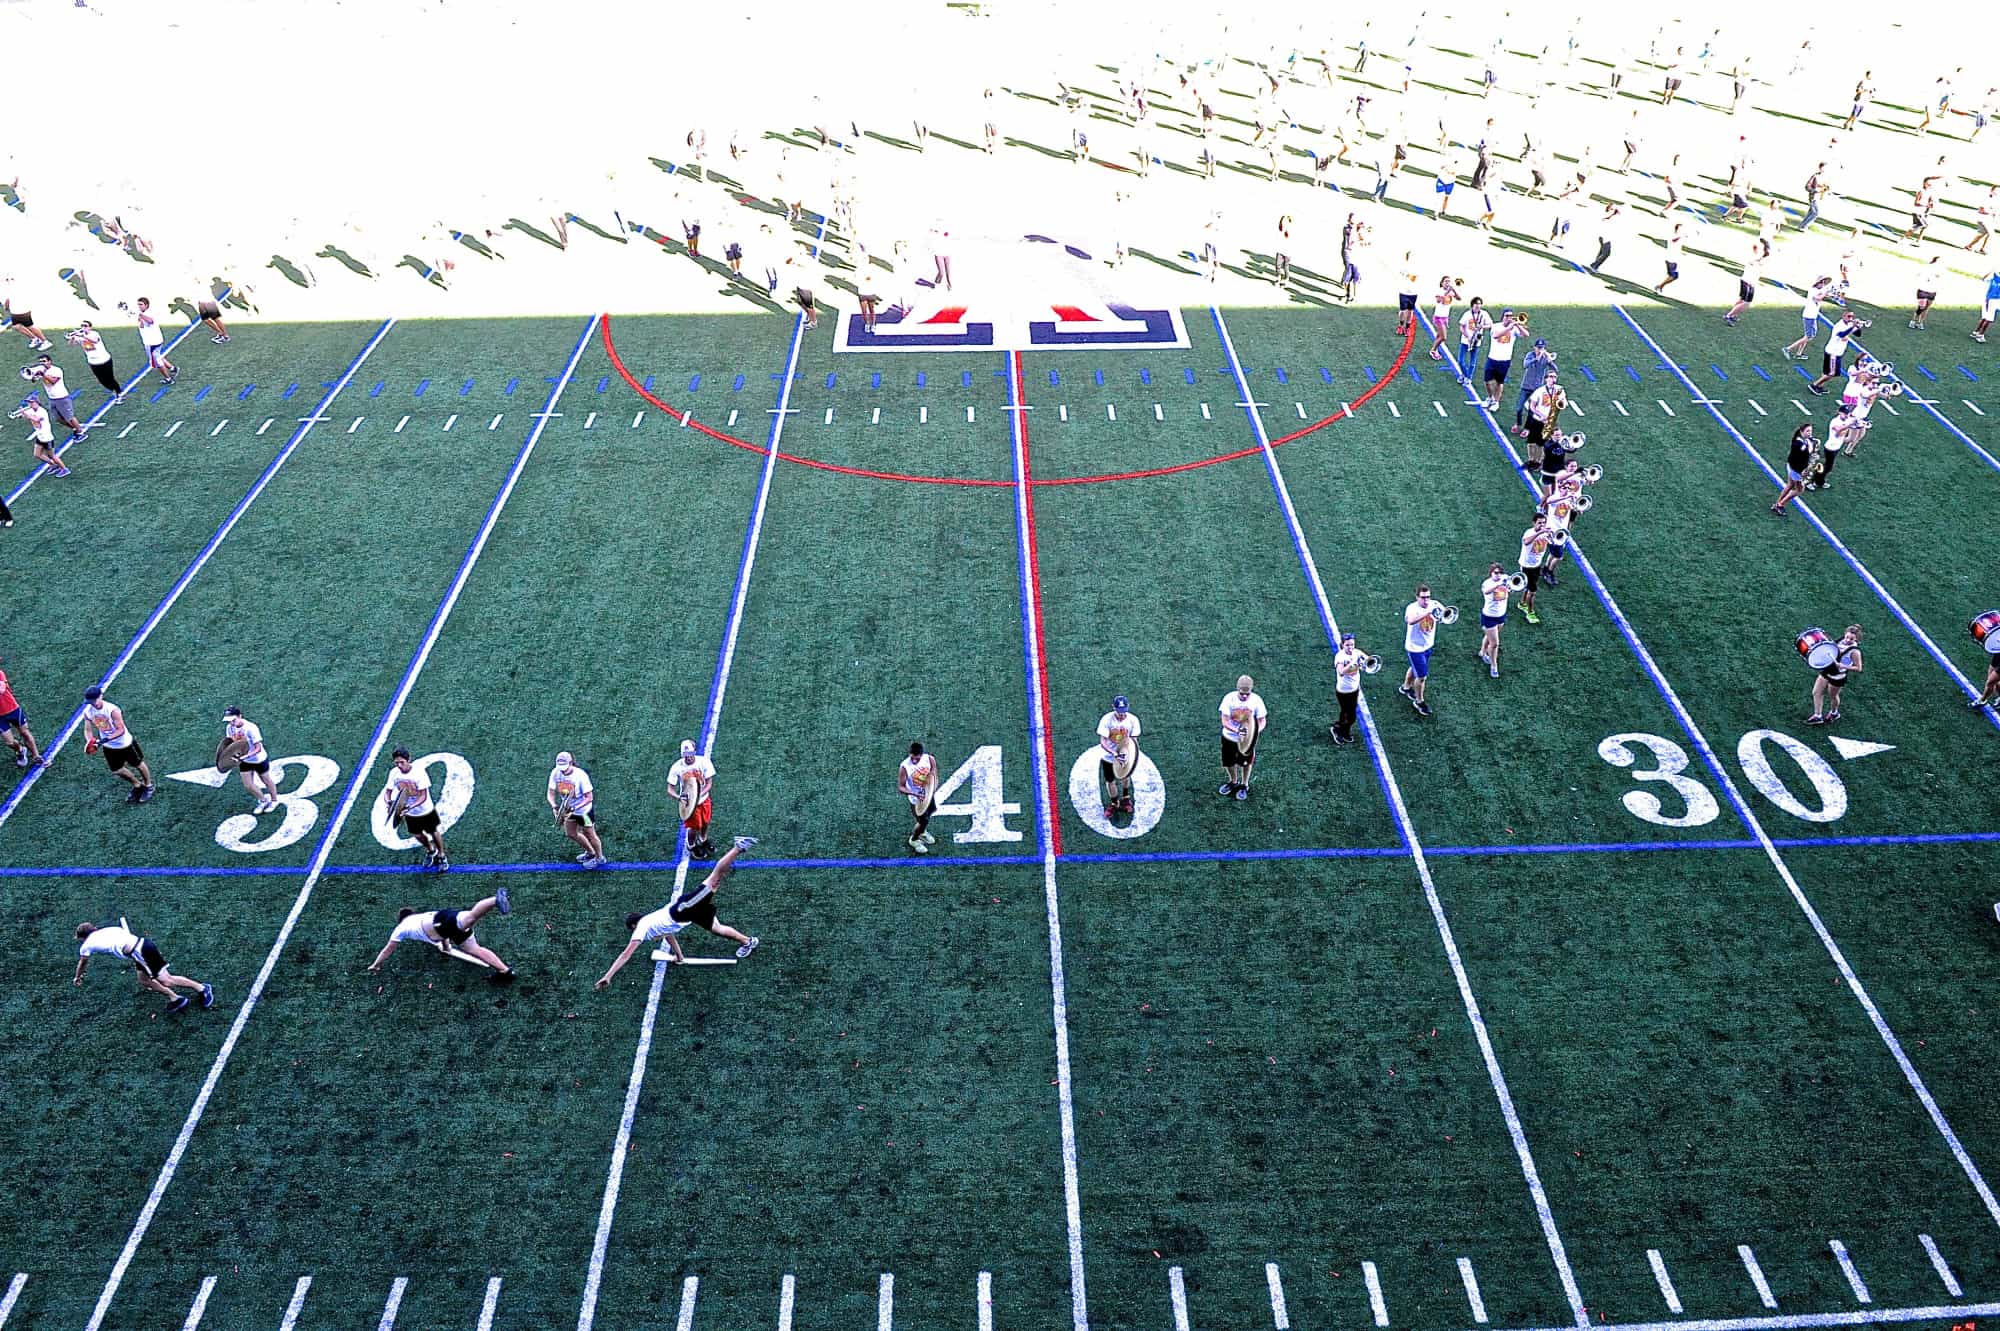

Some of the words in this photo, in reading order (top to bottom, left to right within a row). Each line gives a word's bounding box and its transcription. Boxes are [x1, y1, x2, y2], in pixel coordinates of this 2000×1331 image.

[214, 752, 474, 853] 30
[931, 745, 1166, 844] 40
[1598, 729, 1848, 827] 30
